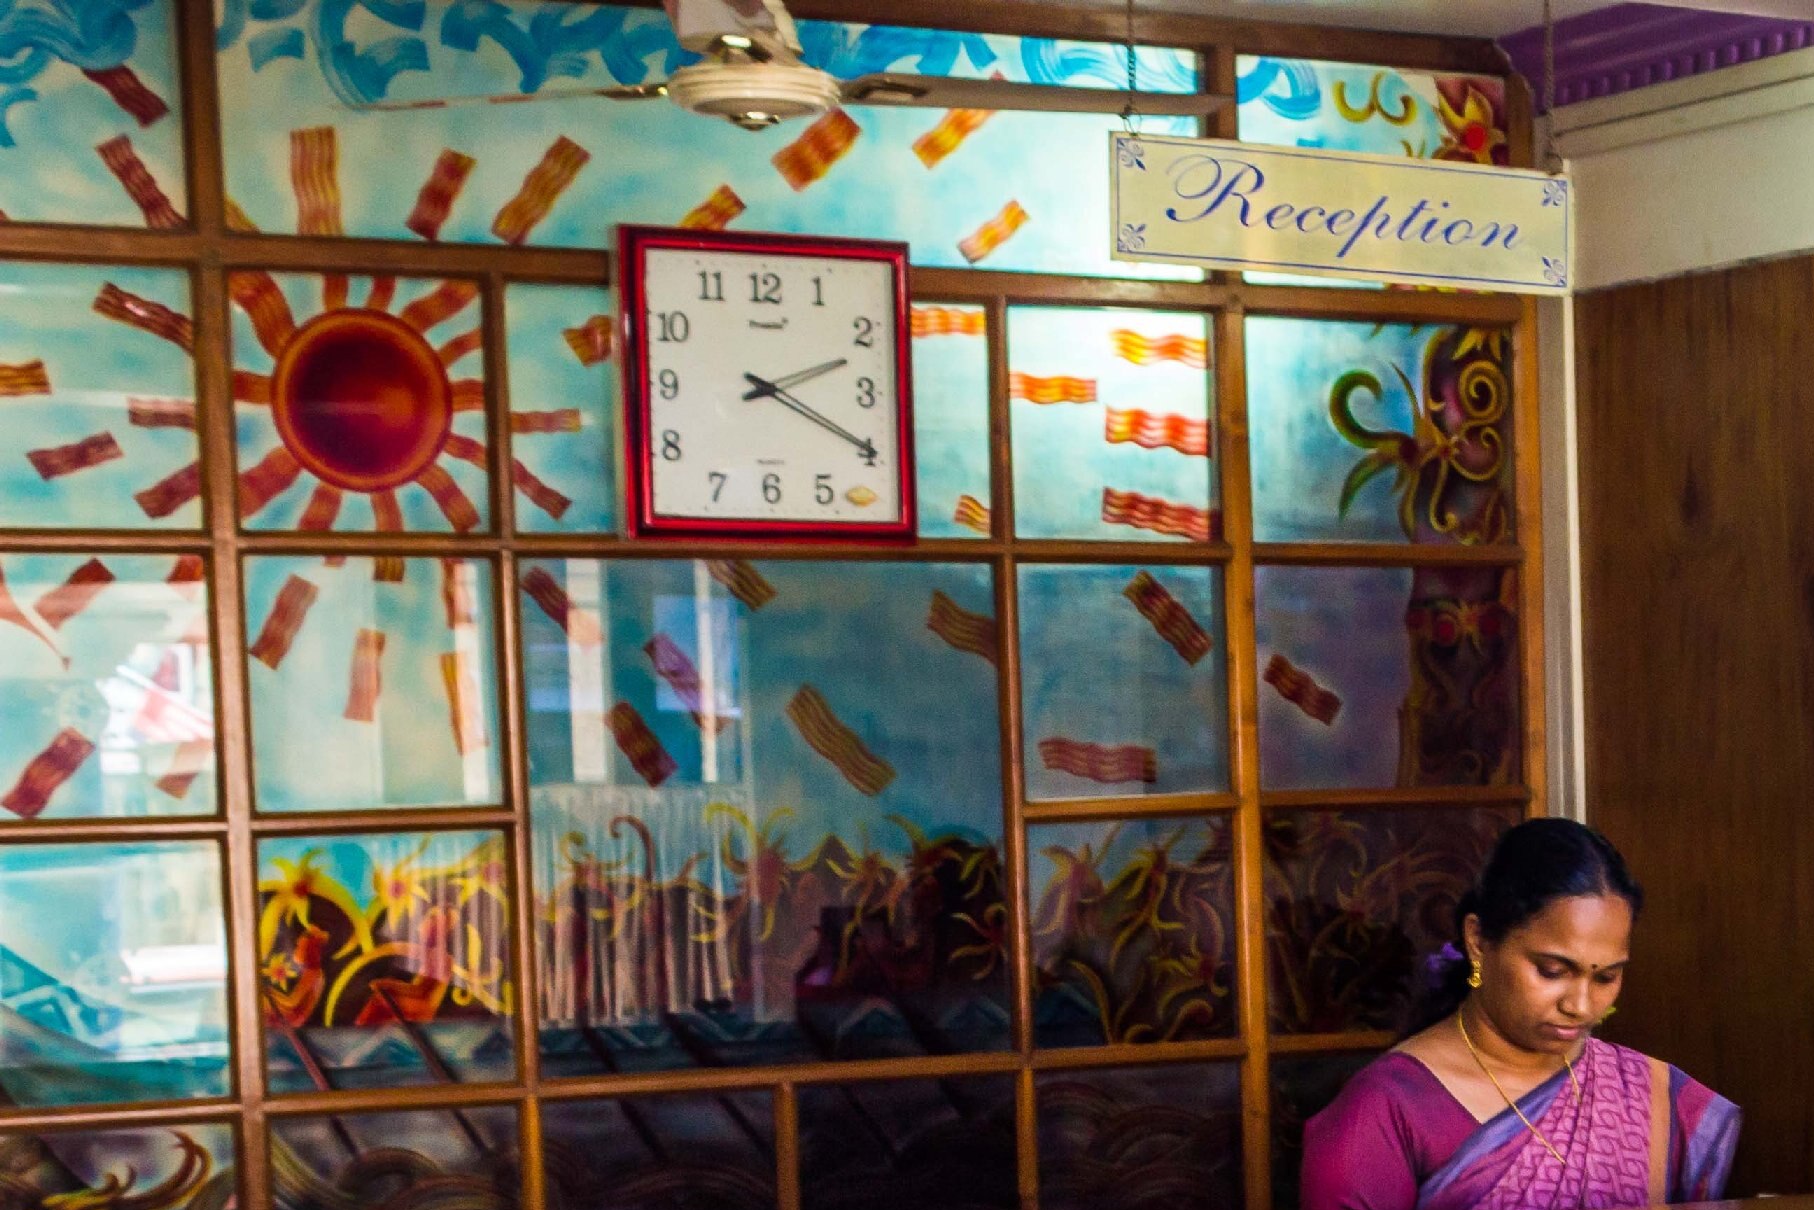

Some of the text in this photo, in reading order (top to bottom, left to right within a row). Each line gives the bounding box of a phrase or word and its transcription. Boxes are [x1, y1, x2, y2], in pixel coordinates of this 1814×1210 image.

[1165, 153, 1523, 259] Reception
[698, 269, 726, 302] 11
[747, 271, 784, 306] 12
[810, 275, 826, 307] 1
[656, 310, 691, 343] 10
[852, 315, 874, 349] 2
[658, 368, 680, 400] 9
[855, 376, 876, 410] 3
[661, 429, 683, 462] 8
[856, 437, 877, 467] 4
[707, 471, 728, 503] 7
[761, 473, 783, 505] 6
[813, 473, 835, 505] 5
